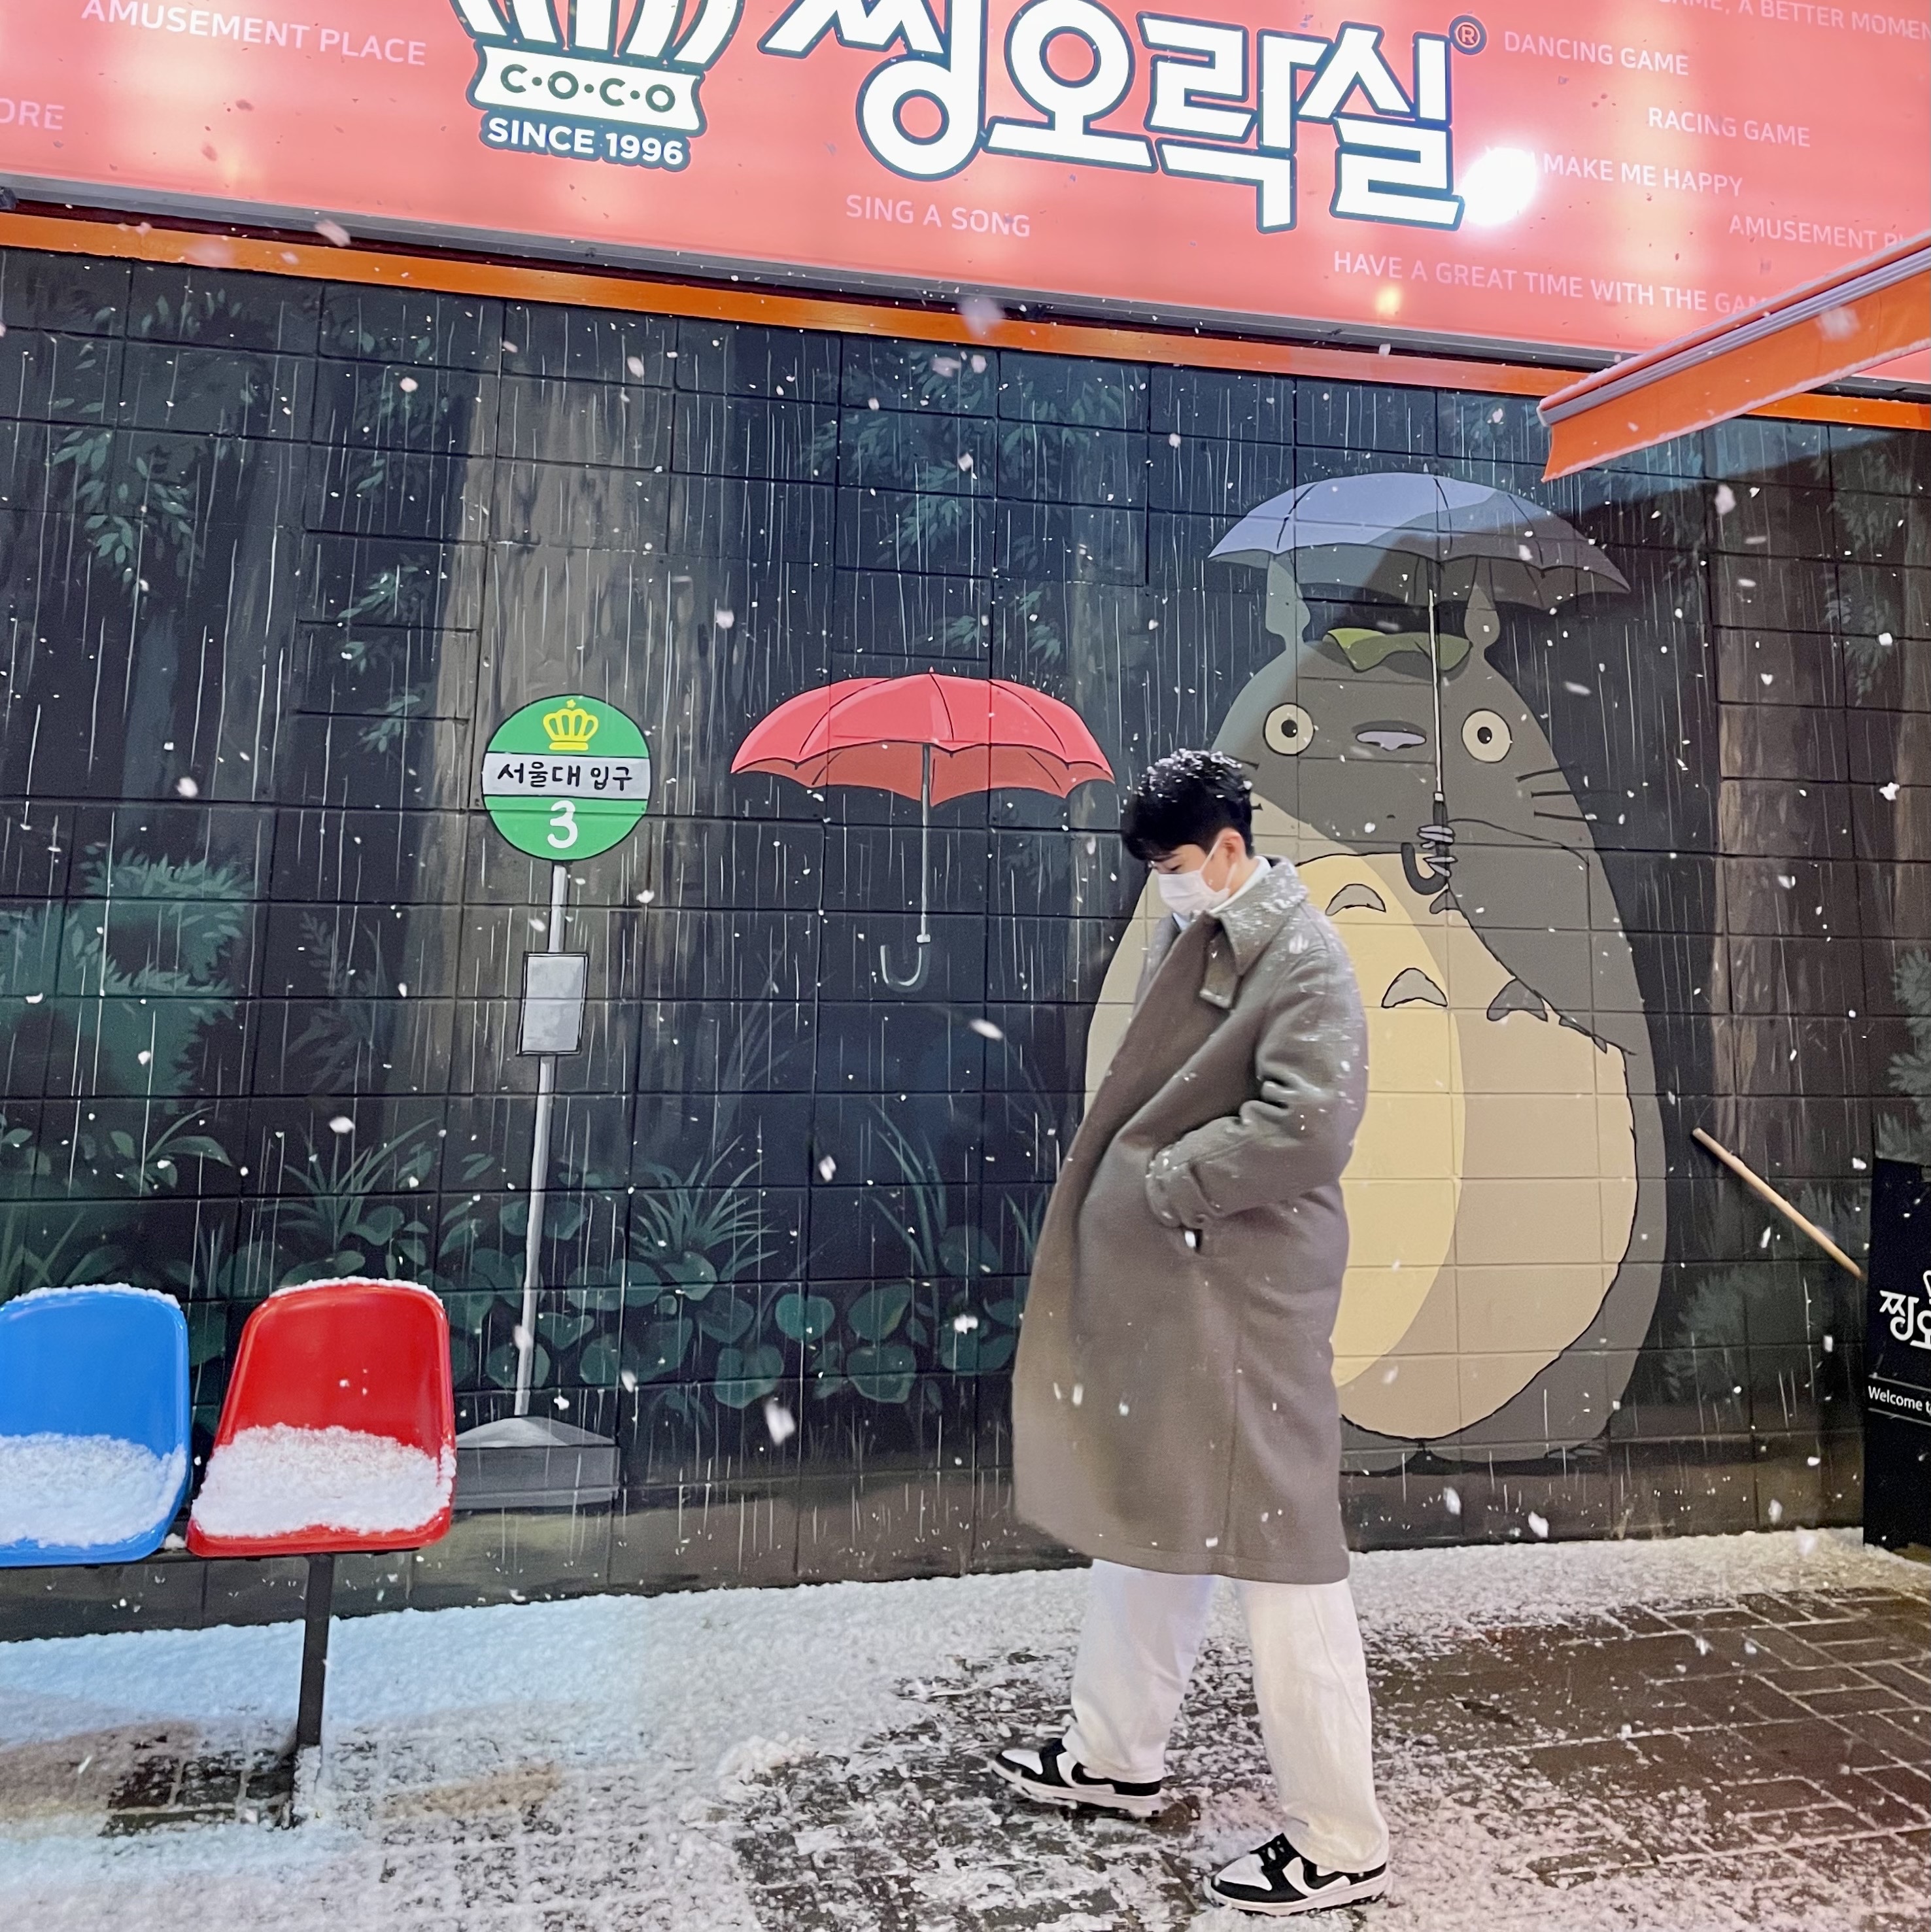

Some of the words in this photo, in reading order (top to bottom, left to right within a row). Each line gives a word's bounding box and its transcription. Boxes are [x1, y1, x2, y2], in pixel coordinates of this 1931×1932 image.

[81, 0, 310, 49] AMUSEMENT
[320, 28, 426, 65] PLACE
[1761, 0, 1844, 29] BETTER
[1505, 31, 1613, 65] DANCING
[1620, 48, 1689, 76] GAME
[487, 117, 594, 154] SINCE
[606, 132, 684, 165] 1996
[1649, 107, 1737, 138] RACING
[1744, 120, 1811, 148] GAME
[1543, 153, 1614, 182] MAKE
[1621, 162, 1657, 187] ME
[1664, 167, 1743, 197] HAPPY
[846, 194, 914, 224] SING
[923, 203, 942, 228] A
[951, 207, 1031, 237] SONG
[1729, 215, 1877, 250] AMUSEMENT
[1334, 250, 1403, 279] HAVE
[1410, 260, 1428, 282] A
[1436, 262, 1517, 290] GREAT
[1524, 271, 1584, 298] TIME
[1590, 279, 1654, 305] WITH
[1660, 286, 1707, 312] THE
[547, 799, 579, 849] 3
[1868, 1385, 1923, 1412] Welcome
